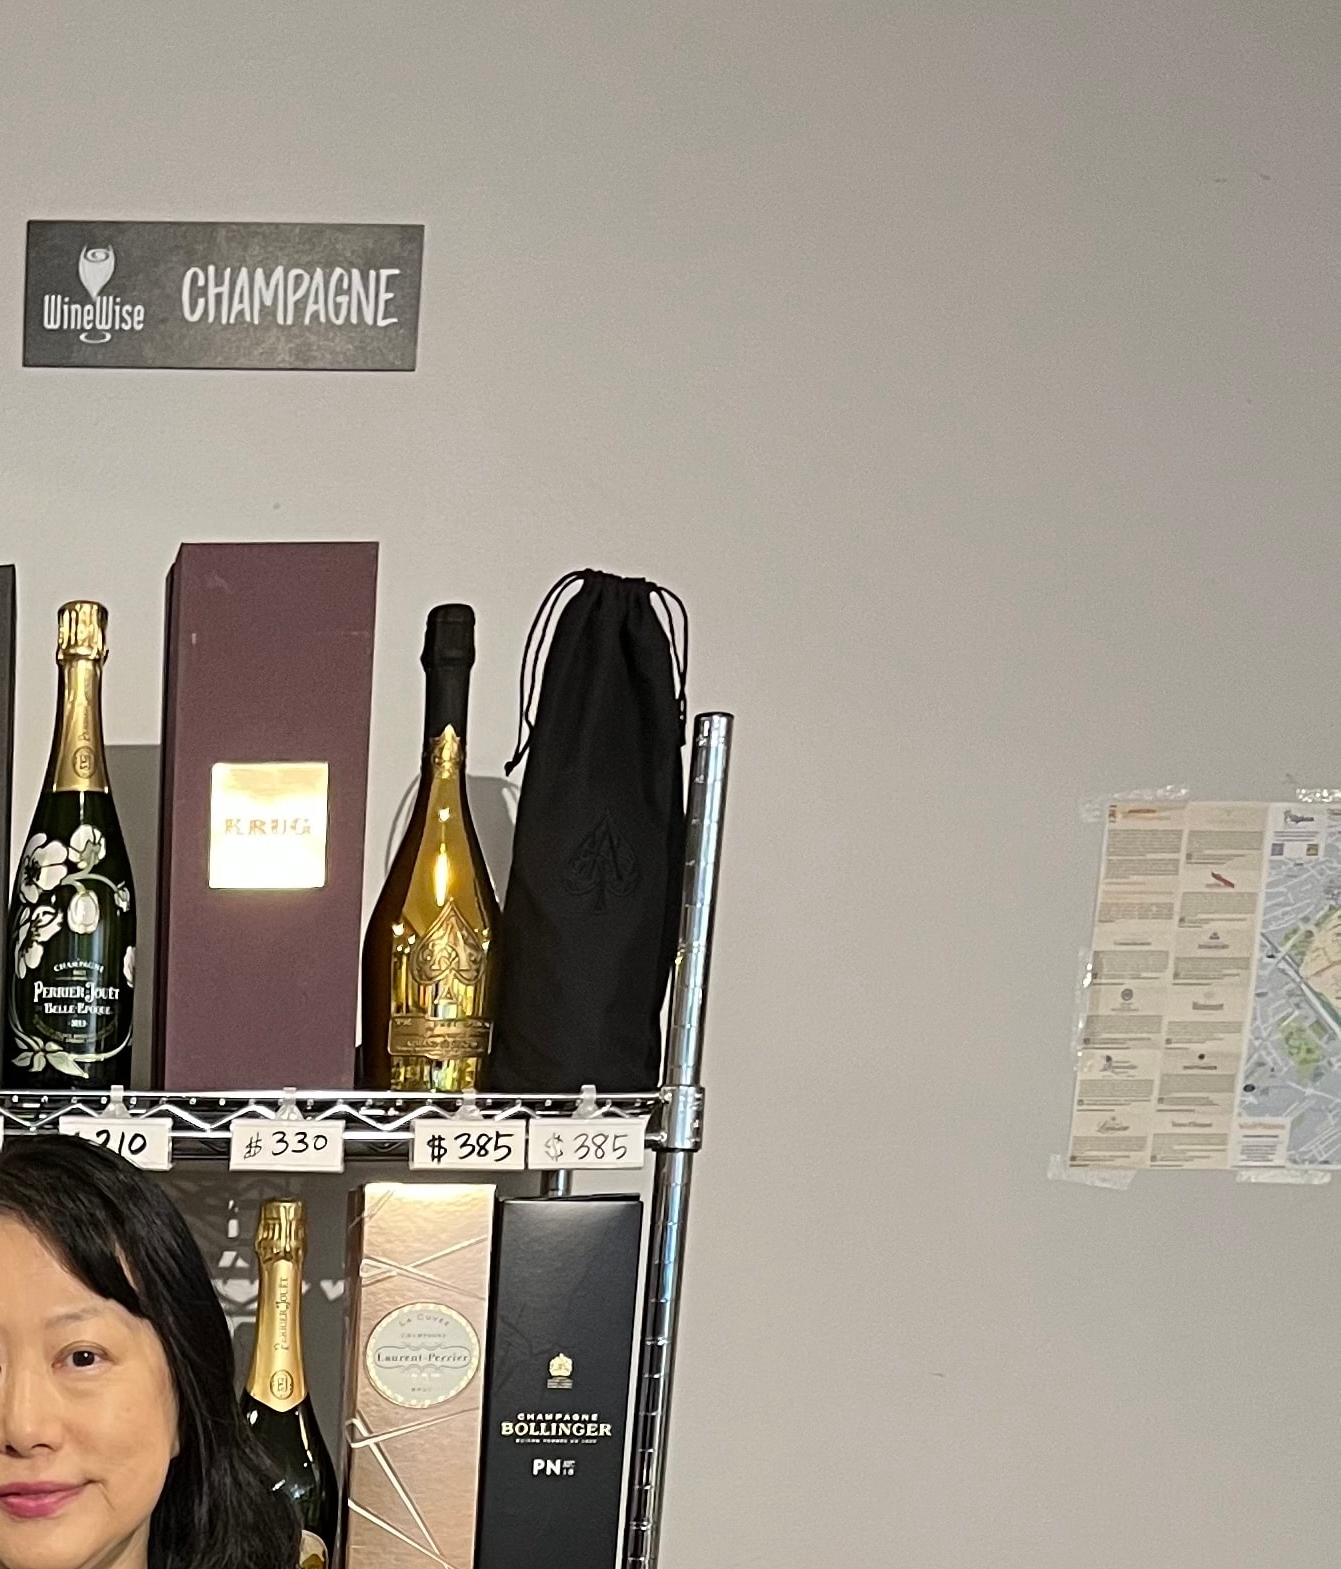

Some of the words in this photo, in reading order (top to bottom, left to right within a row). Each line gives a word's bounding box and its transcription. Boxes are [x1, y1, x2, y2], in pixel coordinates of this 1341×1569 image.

[181, 265, 401, 327] CHAMPAGNE
[43, 294, 145, 330] WineWise
[224, 818, 311, 836] KRUG
[243, 1130, 328, 1161] $330
[425, 1130, 515, 1165] $385
[500, 1421, 612, 1437] BOLLINGER
[516, 1412, 599, 1422] CHAMPAGNE
[532, 1458, 562, 1476] PN
